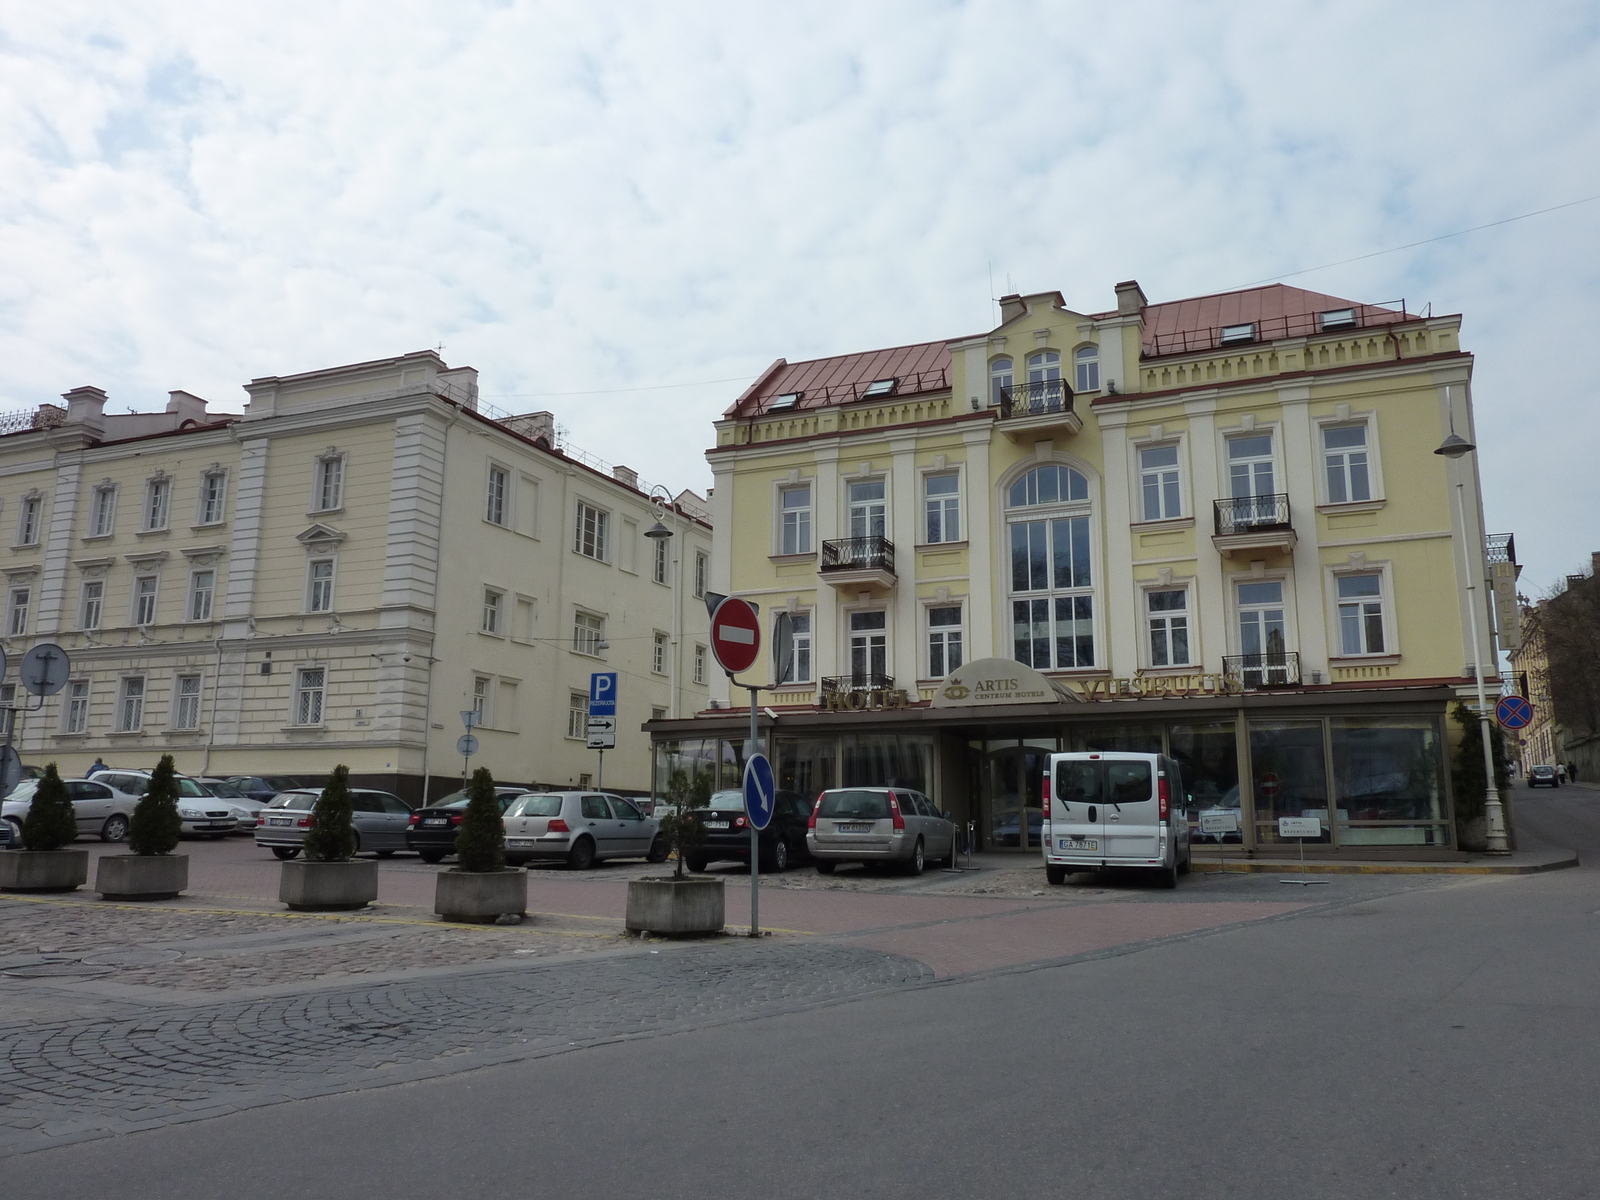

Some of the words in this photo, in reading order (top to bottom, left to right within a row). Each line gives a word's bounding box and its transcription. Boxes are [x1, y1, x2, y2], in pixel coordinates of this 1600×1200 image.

[1495, 564, 1516, 648] HOTEL
[595, 675, 611, 700] P
[974, 678, 1018, 692] ARTIS
[974, 692, 1012, 700] CENTRUM
[1014, 691, 1045, 699] HOTELS
[1077, 671, 1242, 700] VIEŠBUTIS
[825, 689, 911, 711] HOTEL
